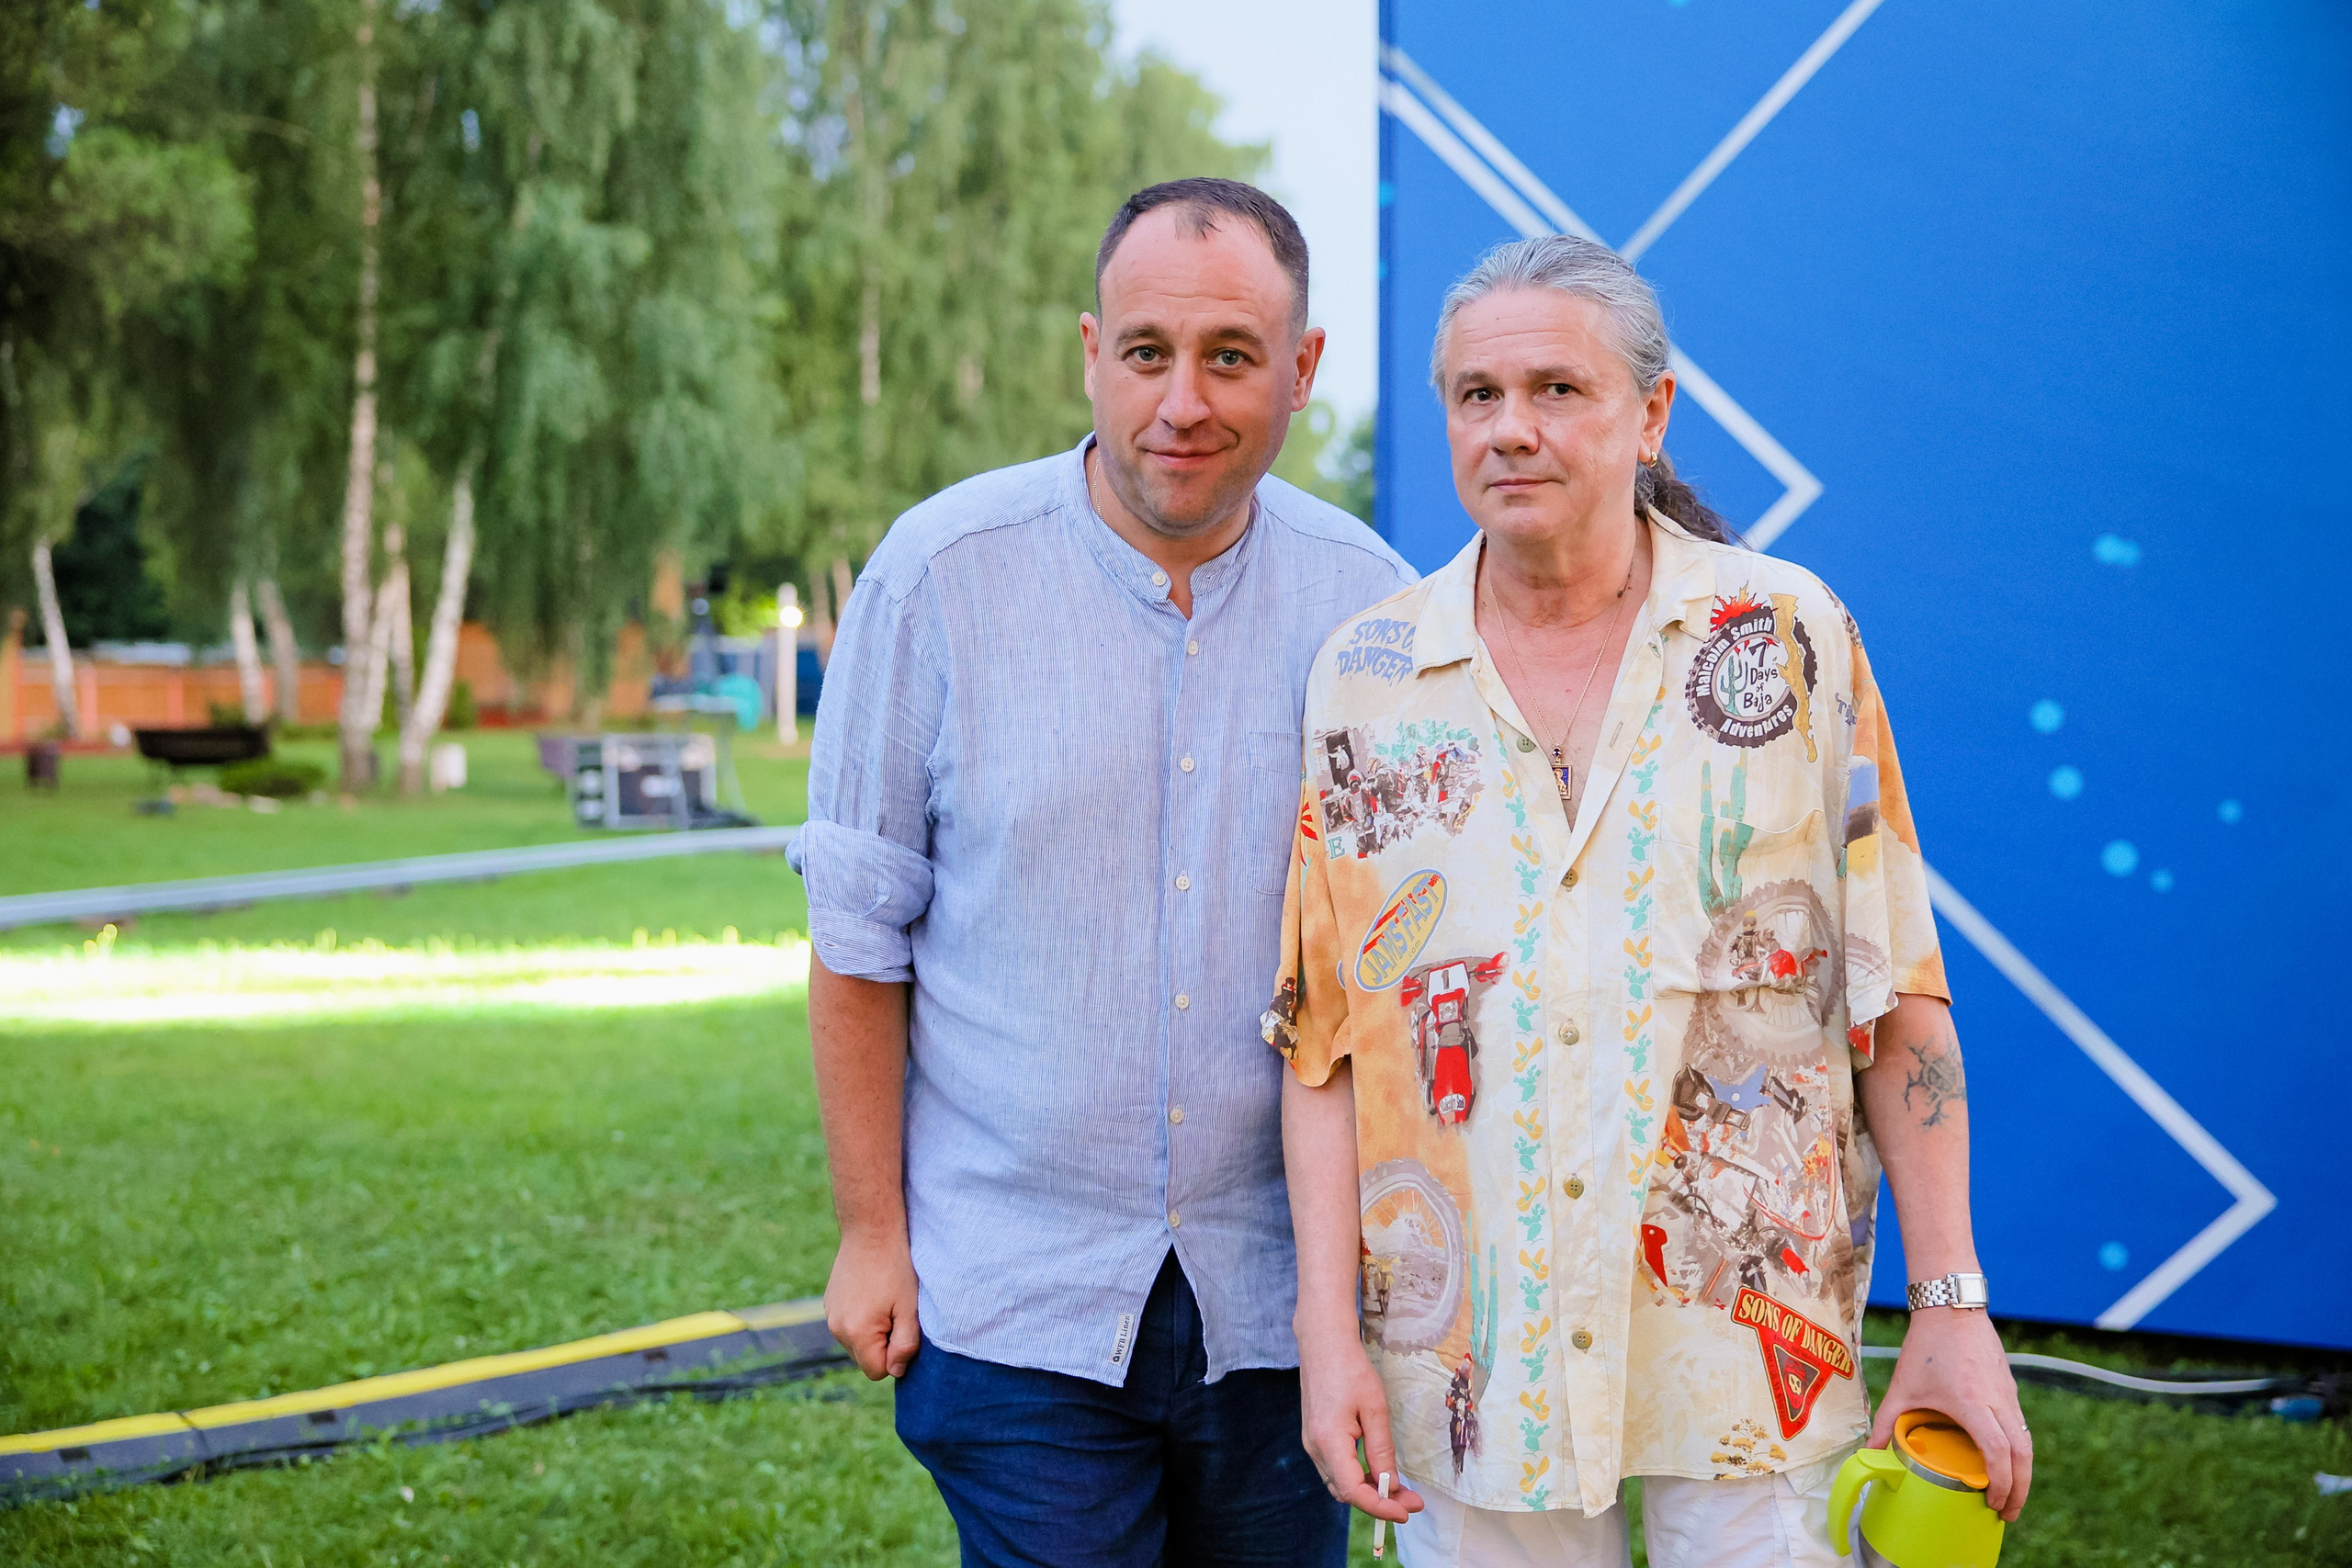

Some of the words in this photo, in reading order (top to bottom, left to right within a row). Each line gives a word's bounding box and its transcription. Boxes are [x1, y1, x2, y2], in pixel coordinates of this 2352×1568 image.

[1348, 618, 1410, 646] SONS
[1337, 646, 1414, 684] DANGER
[1696, 638, 1731, 697] Malcolm
[1730, 616, 1773, 640] Smith
[1748, 640, 1768, 667] 7
[1750, 667, 1779, 685] Days
[1756, 682, 1765, 693] of
[1743, 692, 1773, 713] Baja
[1719, 704, 1793, 738] Adventures
[1441, 969, 1451, 990] 1
[1737, 1292, 1781, 1332] SONS
[1781, 1314, 1804, 1343] OF
[1801, 1323, 1852, 1374] DANGER
